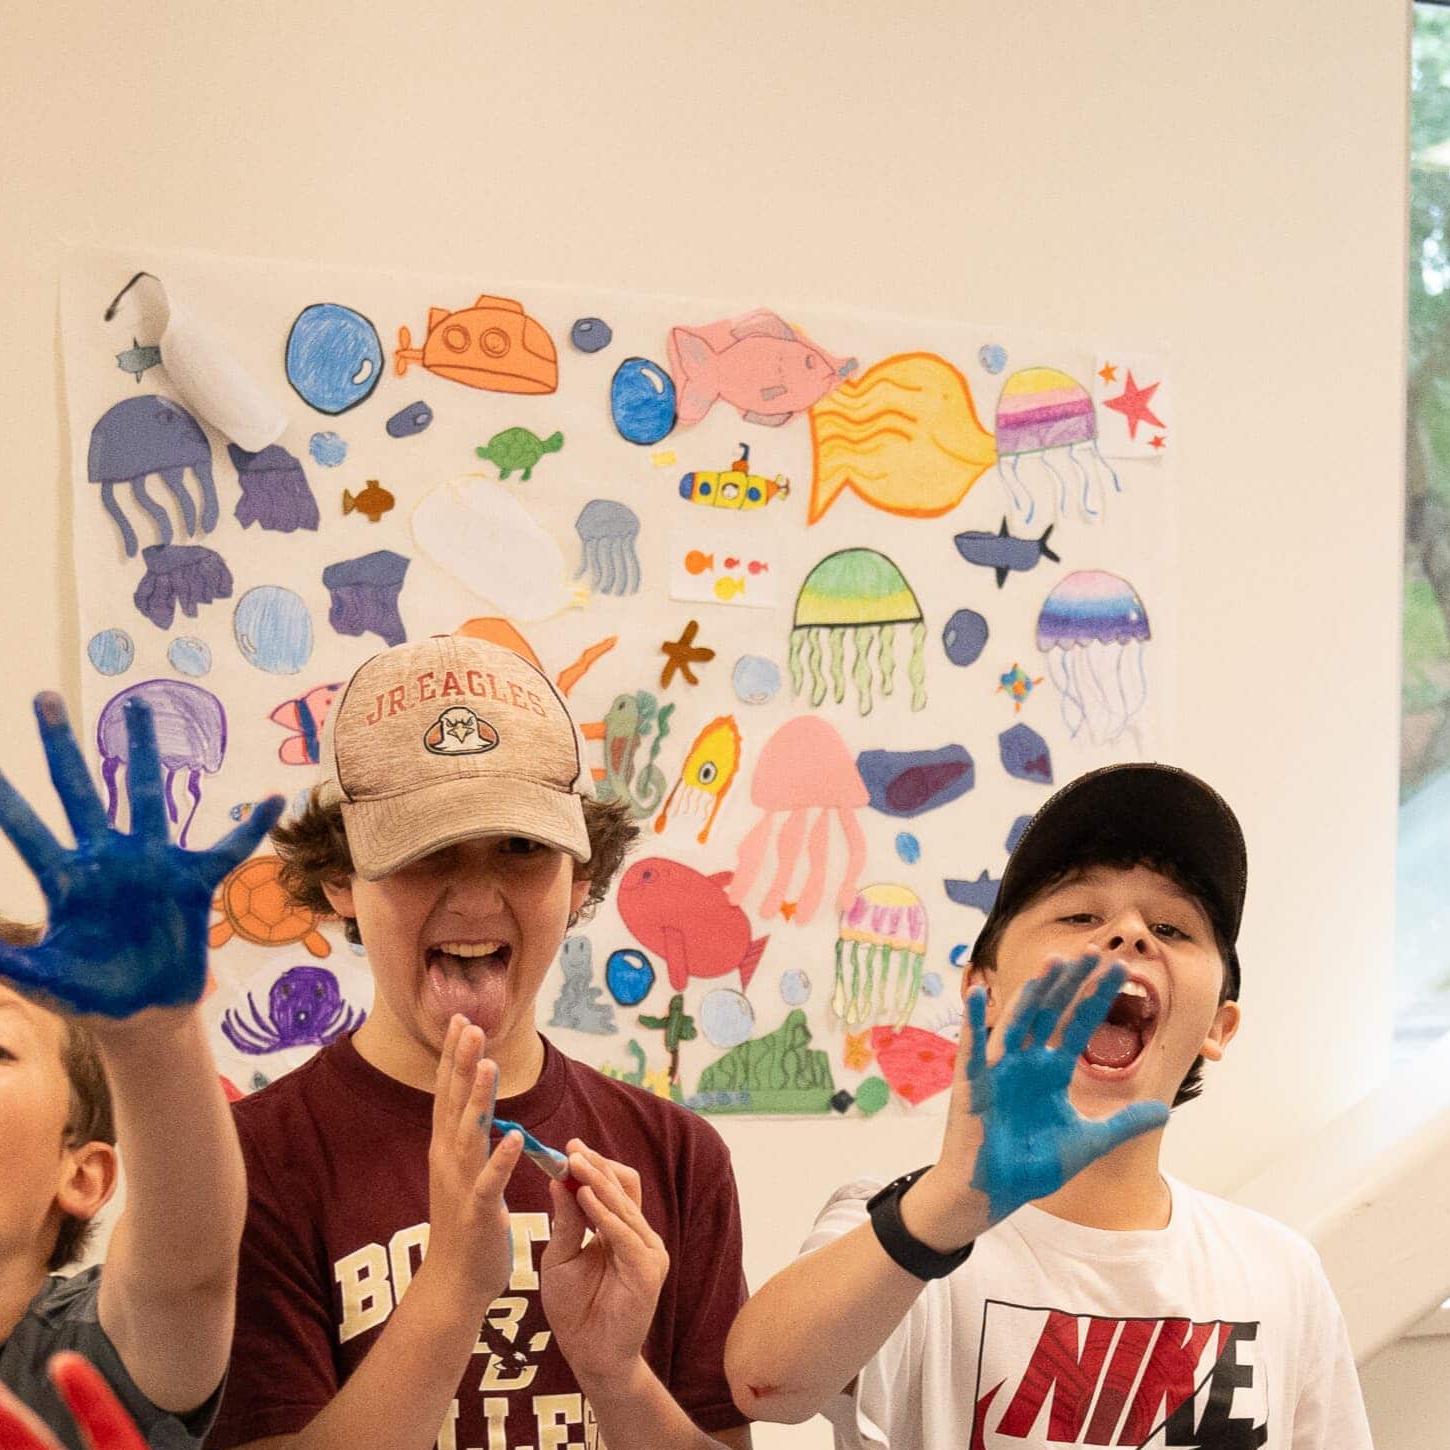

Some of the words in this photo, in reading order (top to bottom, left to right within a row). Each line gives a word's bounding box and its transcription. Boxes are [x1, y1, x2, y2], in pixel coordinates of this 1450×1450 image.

[366, 686, 406, 726] JR
[416, 670, 548, 719] EAGLES
[995, 1310, 1262, 1449] NIKE
